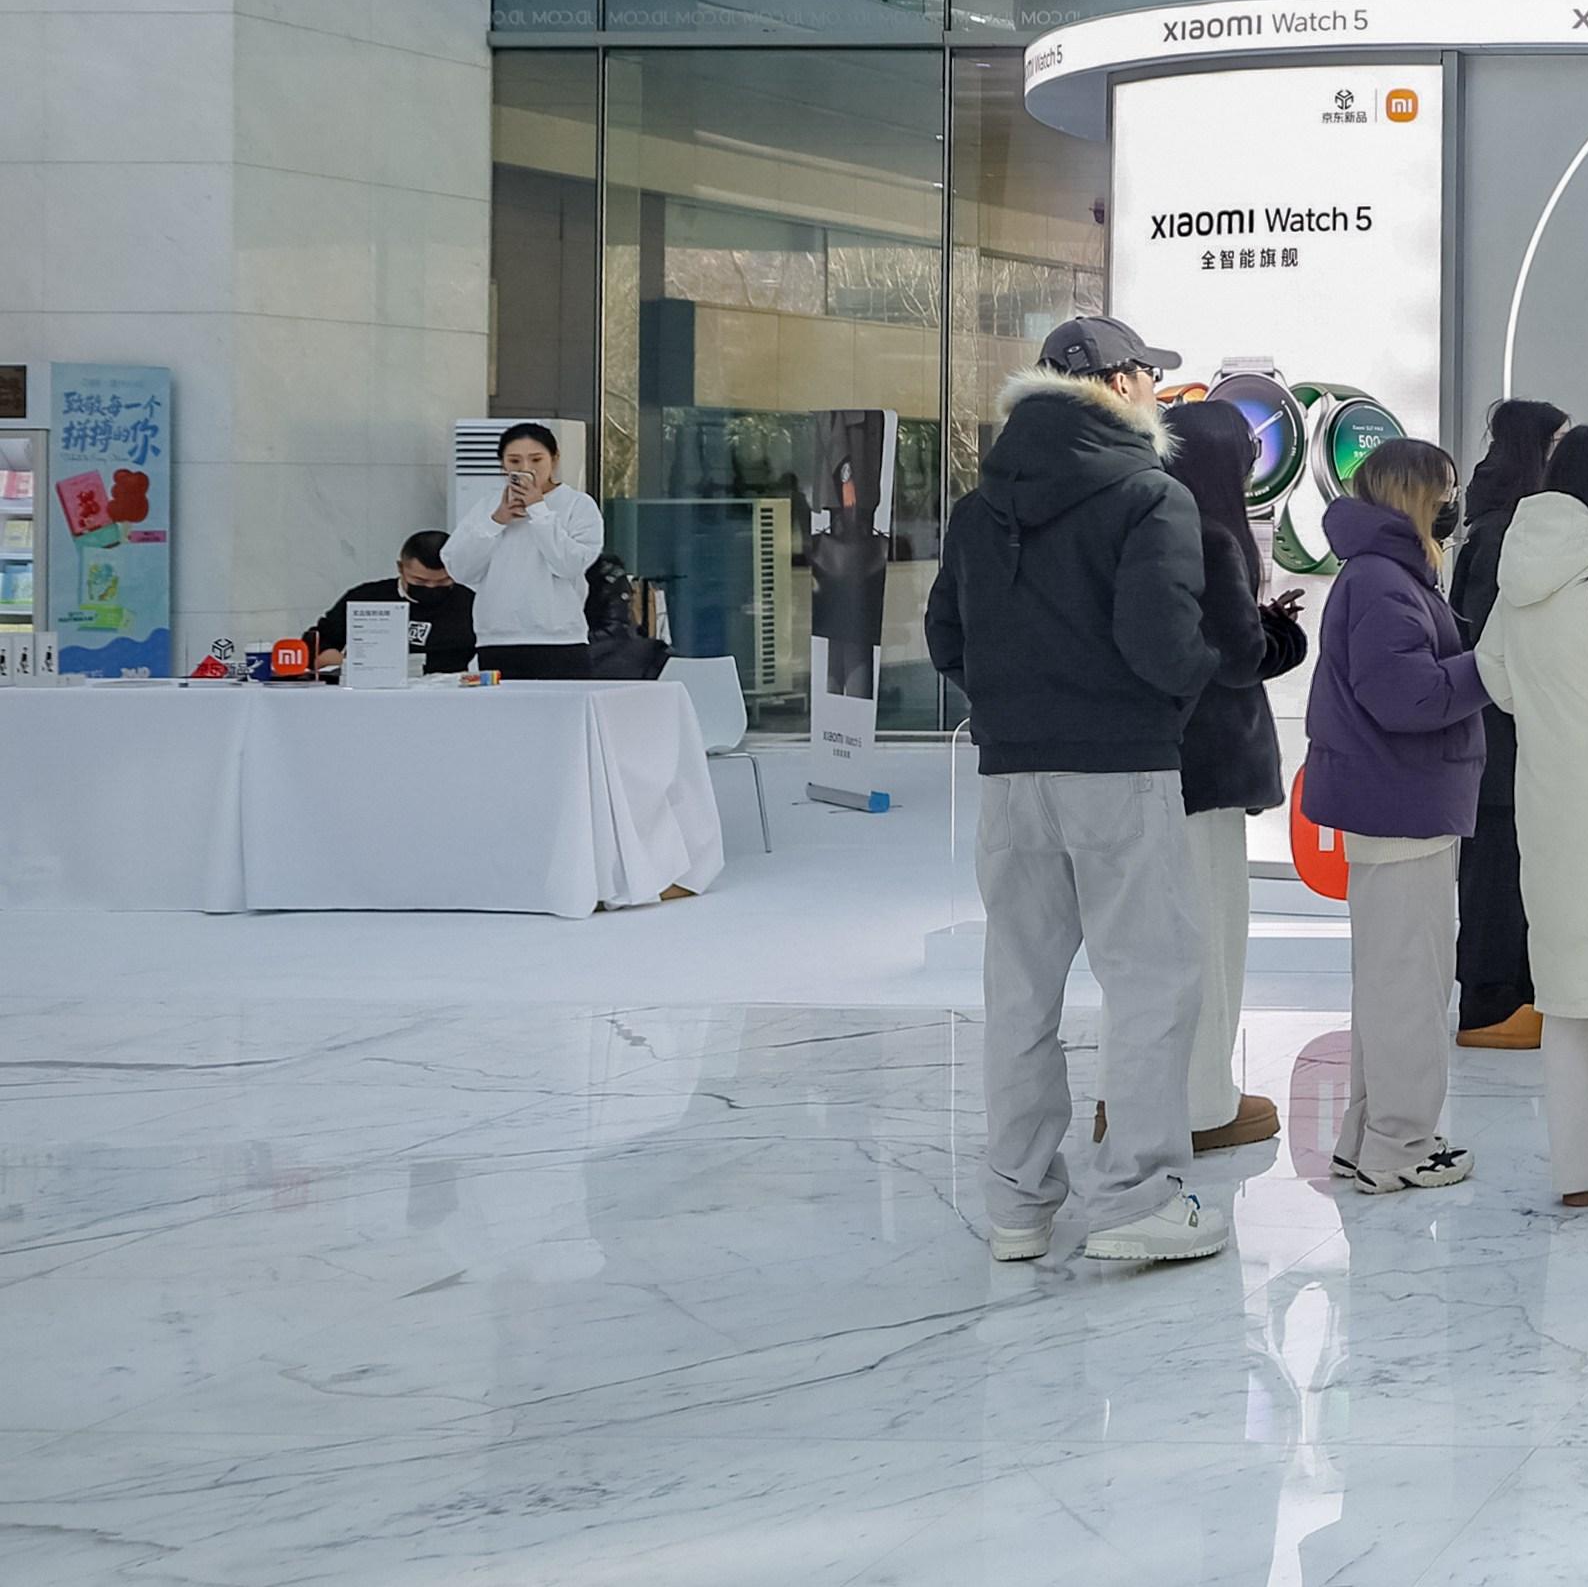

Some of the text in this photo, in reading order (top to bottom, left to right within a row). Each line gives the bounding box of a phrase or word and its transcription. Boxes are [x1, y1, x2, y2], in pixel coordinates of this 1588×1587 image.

[1272, 11, 1346, 33] Watch
[1354, 10, 1368, 30] 5
[1056, 44, 1063, 64] 5
[1322, 111, 1367, 123] 京东新品
[1265, 207, 1348, 232] Watch
[1356, 206, 1372, 231] 5
[1201, 248, 1298, 270] 全智能旗舰
[1358, 434, 1381, 449] 500
